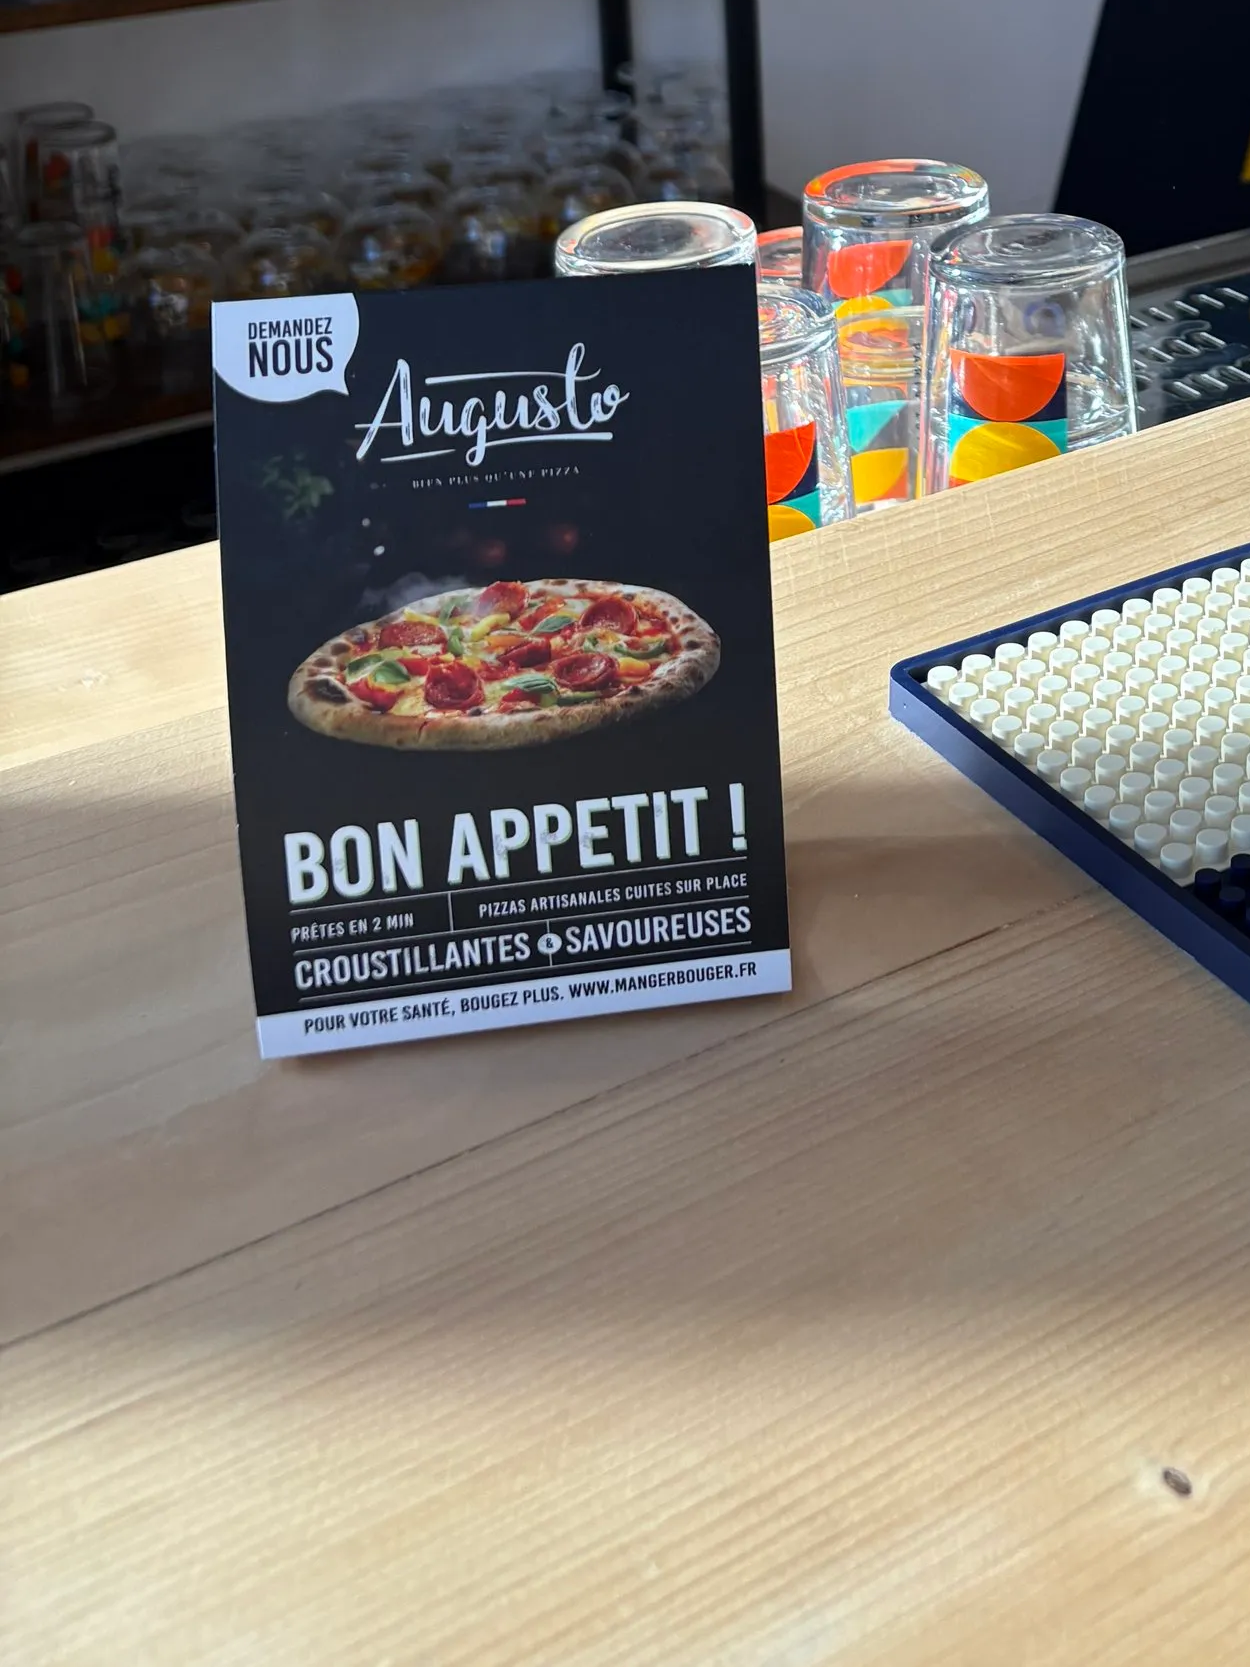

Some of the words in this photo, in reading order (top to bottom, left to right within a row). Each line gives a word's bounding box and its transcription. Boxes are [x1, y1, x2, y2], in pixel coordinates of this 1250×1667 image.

[248, 316, 333, 341] DEMANDEZ
[248, 337, 334, 379] NOUS
[355, 342, 630, 467] Augusto
[412, 478, 442, 489] BIEN
[449, 476, 479, 486] PLUS
[485, 470, 535, 484] QU'UNE
[541, 465, 580, 477] PIZZA
[284, 818, 423, 905] BON
[447, 786, 708, 885] APPETIT
[729, 782, 748, 851] !
[479, 900, 526, 918] PIZZAS
[530, 888, 621, 912] ARTISANALES
[625, 883, 672, 901] CUITES
[676, 878, 701, 894] SUR
[706, 873, 748, 891] PLACE
[291, 919, 345, 943] PRÊTES
[349, 918, 368, 934] EN
[372, 916, 382, 931] 2
[386, 913, 414, 929] MIN
[294, 932, 531, 990] CROUSTILLANTES
[566, 906, 751, 955] SAVOUREUSES
[304, 1014, 346, 1035] POUR
[351, 1007, 398, 1027] VOTRE
[402, 998, 455, 1020] SANTÉ,
[461, 991, 518, 1013] BOUGEZ
[524, 986, 564, 1005] PLUS.
[569, 961, 757, 999] WWW.MANGERBOUGER.FR
